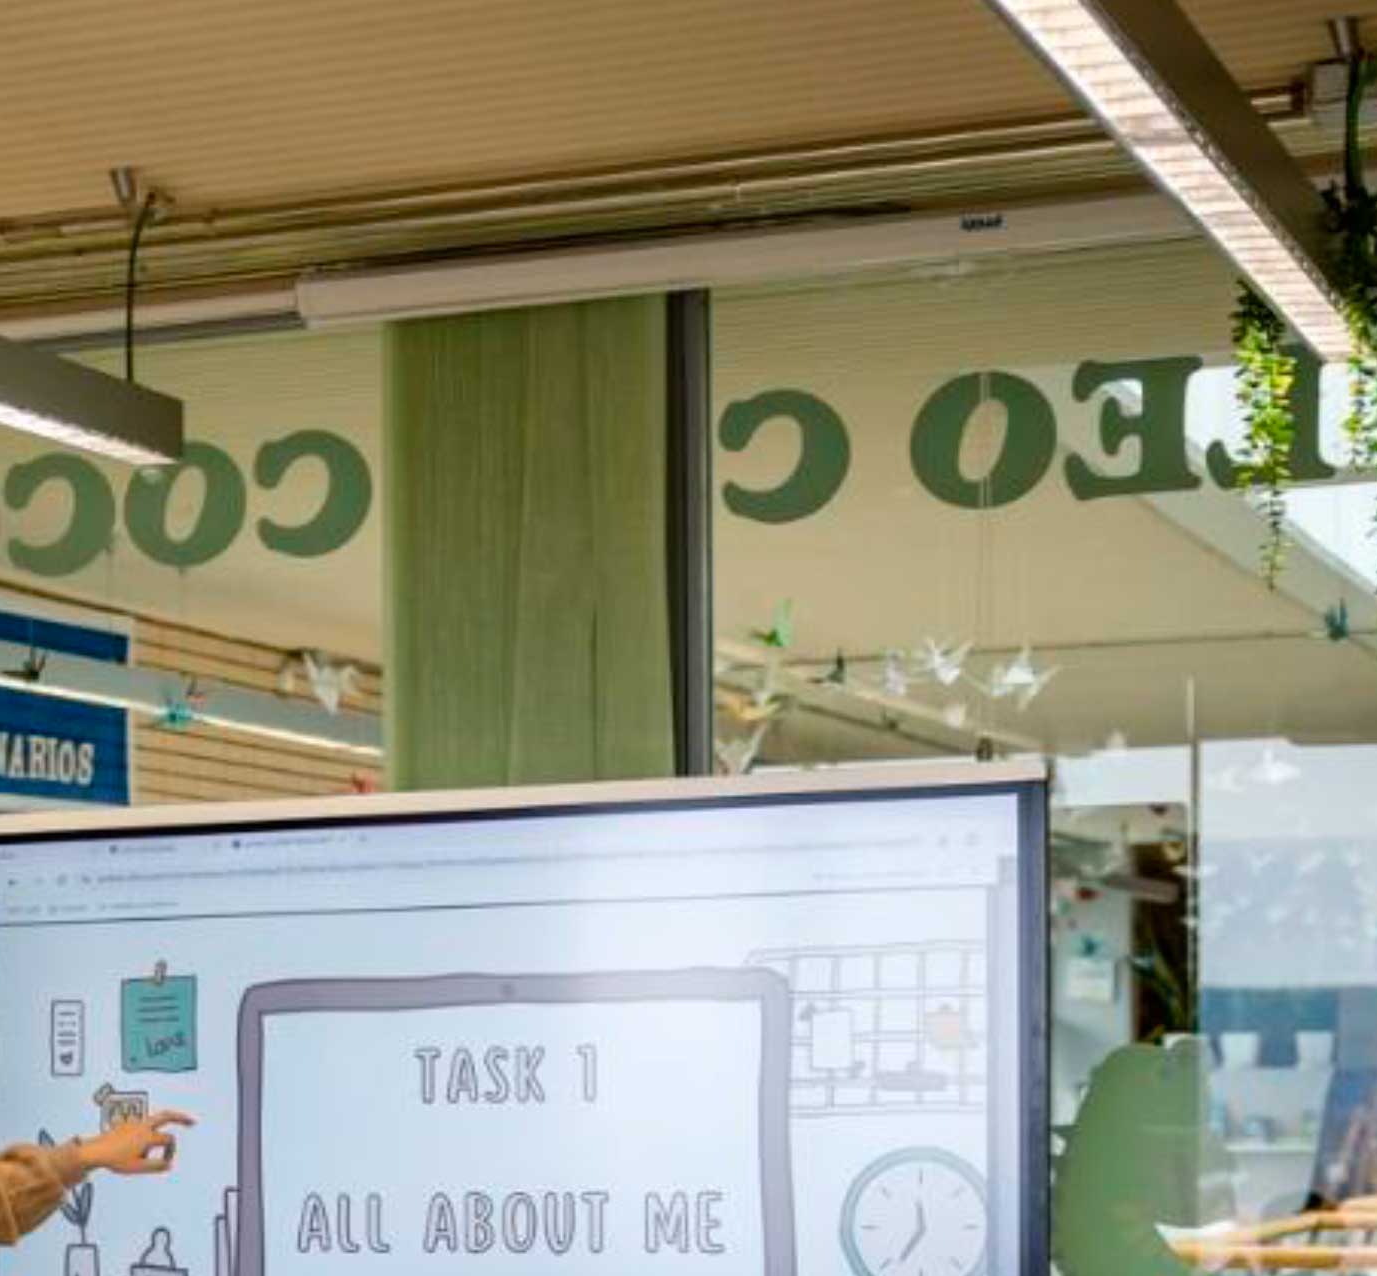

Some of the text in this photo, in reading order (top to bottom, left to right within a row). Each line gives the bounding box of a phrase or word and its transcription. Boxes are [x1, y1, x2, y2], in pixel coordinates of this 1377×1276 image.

[413, 1043, 597, 1104] TASK 1
[296, 1190, 726, 1255] ALL ABOUT ME
